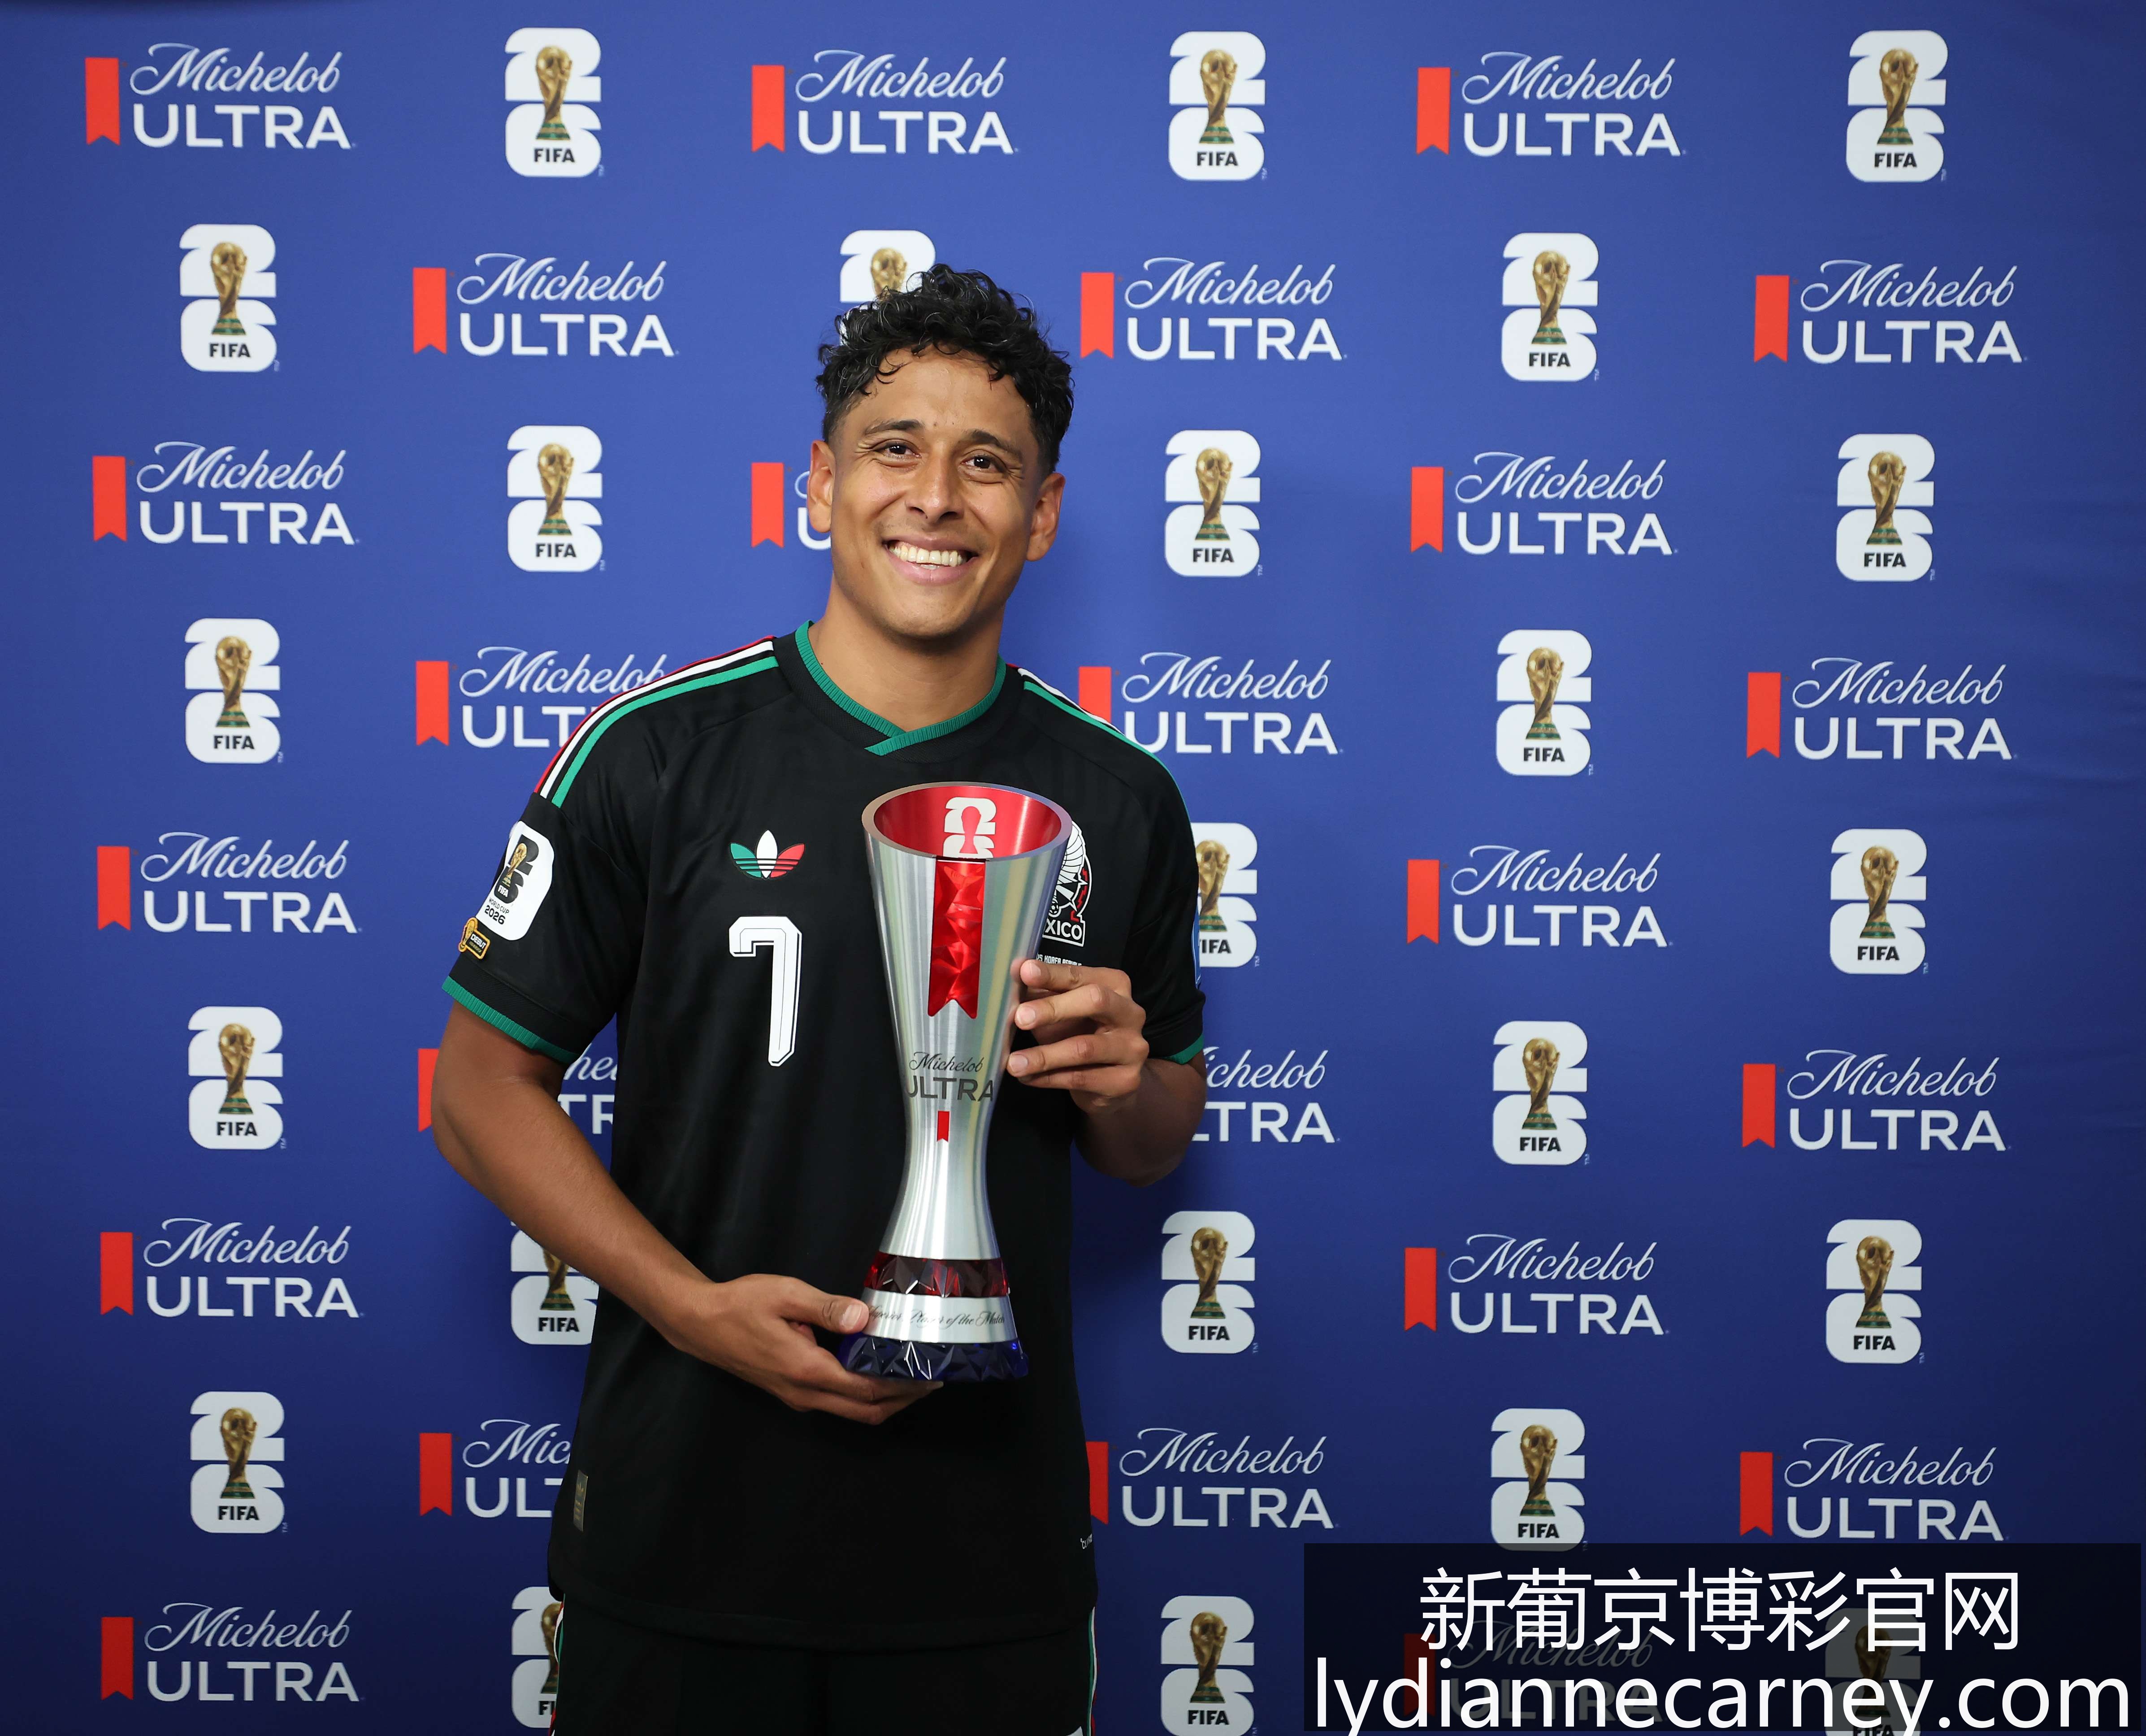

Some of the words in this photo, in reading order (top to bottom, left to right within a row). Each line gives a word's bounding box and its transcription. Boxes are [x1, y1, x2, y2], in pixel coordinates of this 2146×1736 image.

[130, 43, 342, 95] Michelob
[796, 50, 1006, 102] Michelob
[1462, 52, 1675, 104] Michelob
[134, 104, 351, 149] ULTRA
[798, 111, 1013, 154] ULTRA
[1464, 113, 1680, 156] ULTRA
[535, 149, 574, 162] FIFA
[1197, 152, 1237, 165] FIFA
[1875, 153, 1916, 167] FIFA
[457, 253, 666, 304] Michelob
[1125, 257, 1335, 308] Michelob
[1801, 260, 2017, 312] Michelob
[210, 344, 250, 357] FIFA
[460, 313, 674, 356] ULTRA
[1127, 317, 1342, 360] ULTRA
[1803, 321, 2022, 364] ULTRA
[1530, 353, 1570, 366] FIFA
[137, 442, 346, 492] Michelob
[1456, 452, 1666, 503] Michelob
[140, 501, 354, 545] ULTRA
[1458, 512, 1672, 555] ULTRA
[537, 544, 576, 557] FIFA
[1193, 549, 1233, 562] FIFA
[1864, 553, 1906, 567] FIFA
[1122, 652, 1331, 703] Michelob
[1793, 658, 2006, 708] Michelob
[214, 736, 254, 749] FIFA
[462, 705, 598, 748] ULT
[1124, 711, 1338, 754] ULTRA
[1795, 717, 2012, 760] ULTRA
[1524, 748, 1564, 761] FIFA
[141, 832, 348, 881] Michelob
[1452, 845, 1660, 895] Michelob
[144, 890, 357, 933] ULTRA
[498, 885, 509, 897] FIFA
[500, 906, 510, 914] CUP
[485, 905, 506, 925] 2026
[1045, 919, 1083, 940] XICO
[1454, 904, 1667, 947] ULTRA
[470, 933, 486, 949] DEBUT
[1200, 939, 1231, 954] IFA
[1858, 946, 1899, 960] FIFA
[729, 916, 802, 1067] 7
[909, 1051, 984, 1072] Michelob
[1787, 1050, 1999, 1099] Michelob
[217, 1122, 257, 1136] FIFA
[1192, 1102, 1335, 1143] TRA
[1520, 1137, 1561, 1151] FIFA
[1790, 1108, 2006, 1151] ULTRA
[144, 1218, 351, 1267] Michelob
[1449, 1234, 1656, 1283] Michelob
[147, 1276, 359, 1318] ULTRA
[1451, 1292, 1664, 1335] ULTRA
[539, 1317, 579, 1332] FIFA
[1189, 1326, 1229, 1340] FIFA
[1854, 1336, 1895, 1350] FIFA
[1120, 1428, 1327, 1476] Michelob
[1785, 1438, 1996, 1487] Michelob
[219, 1506, 259, 1520] FIFA
[1123, 1486, 1334, 1528] ULTRA
[1787, 1497, 2003, 1541] ULTRA
[1518, 1523, 1558, 1539] FIFA
[145, 1603, 352, 1651] Michelob
[147, 1661, 359, 1701] ULTRA
[1188, 1710, 1229, 1725] FIFA
